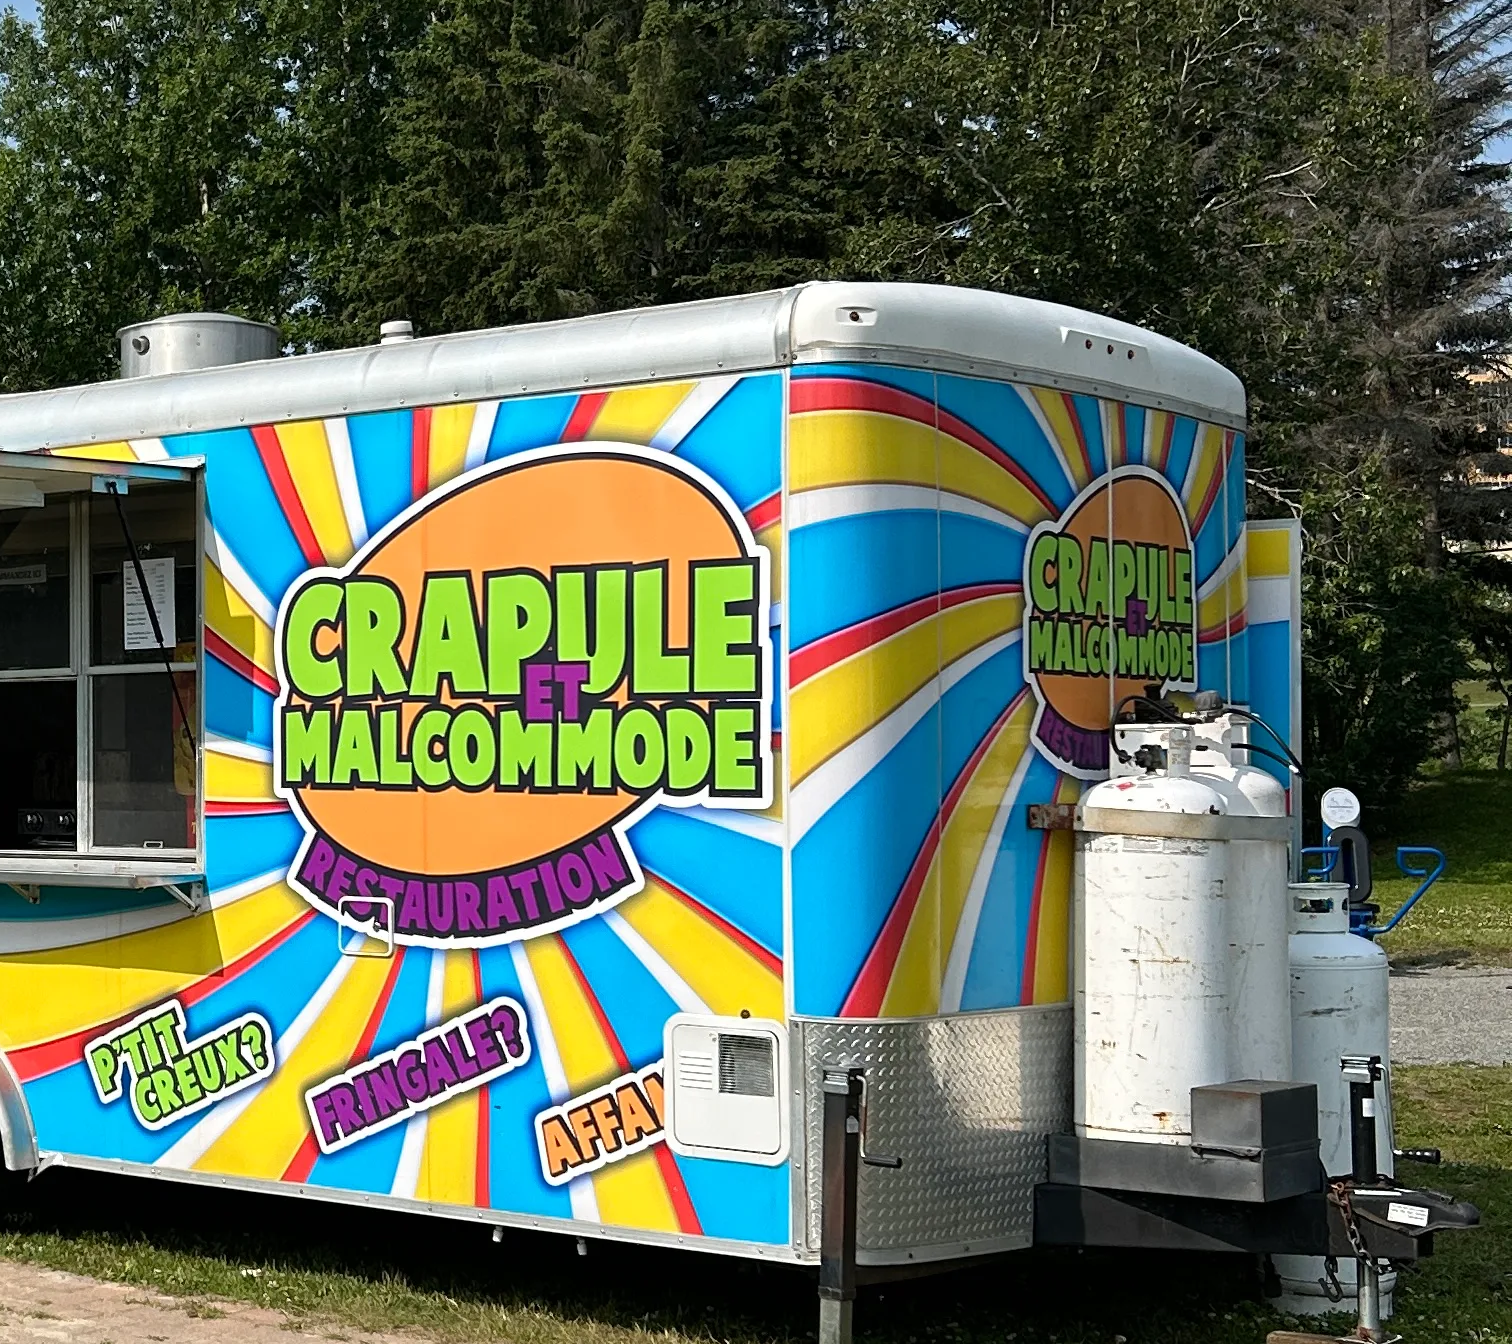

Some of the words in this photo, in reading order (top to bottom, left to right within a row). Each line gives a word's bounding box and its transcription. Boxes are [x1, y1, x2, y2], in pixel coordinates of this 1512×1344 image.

[1031, 534, 1193, 625] CRAPULE
[1126, 600, 1148, 635] ET
[285, 562, 759, 699] CRAPULE
[1031, 620, 1194, 678] MALCOMMODE
[525, 664, 589, 721] ET
[284, 706, 758, 790] MALCOMMODE
[301, 832, 627, 932] RESTAURATION
[91, 1010, 180, 1094] P'TIT
[134, 1020, 266, 1123] CREUX?
[312, 1005, 522, 1144] FRINGALE?
